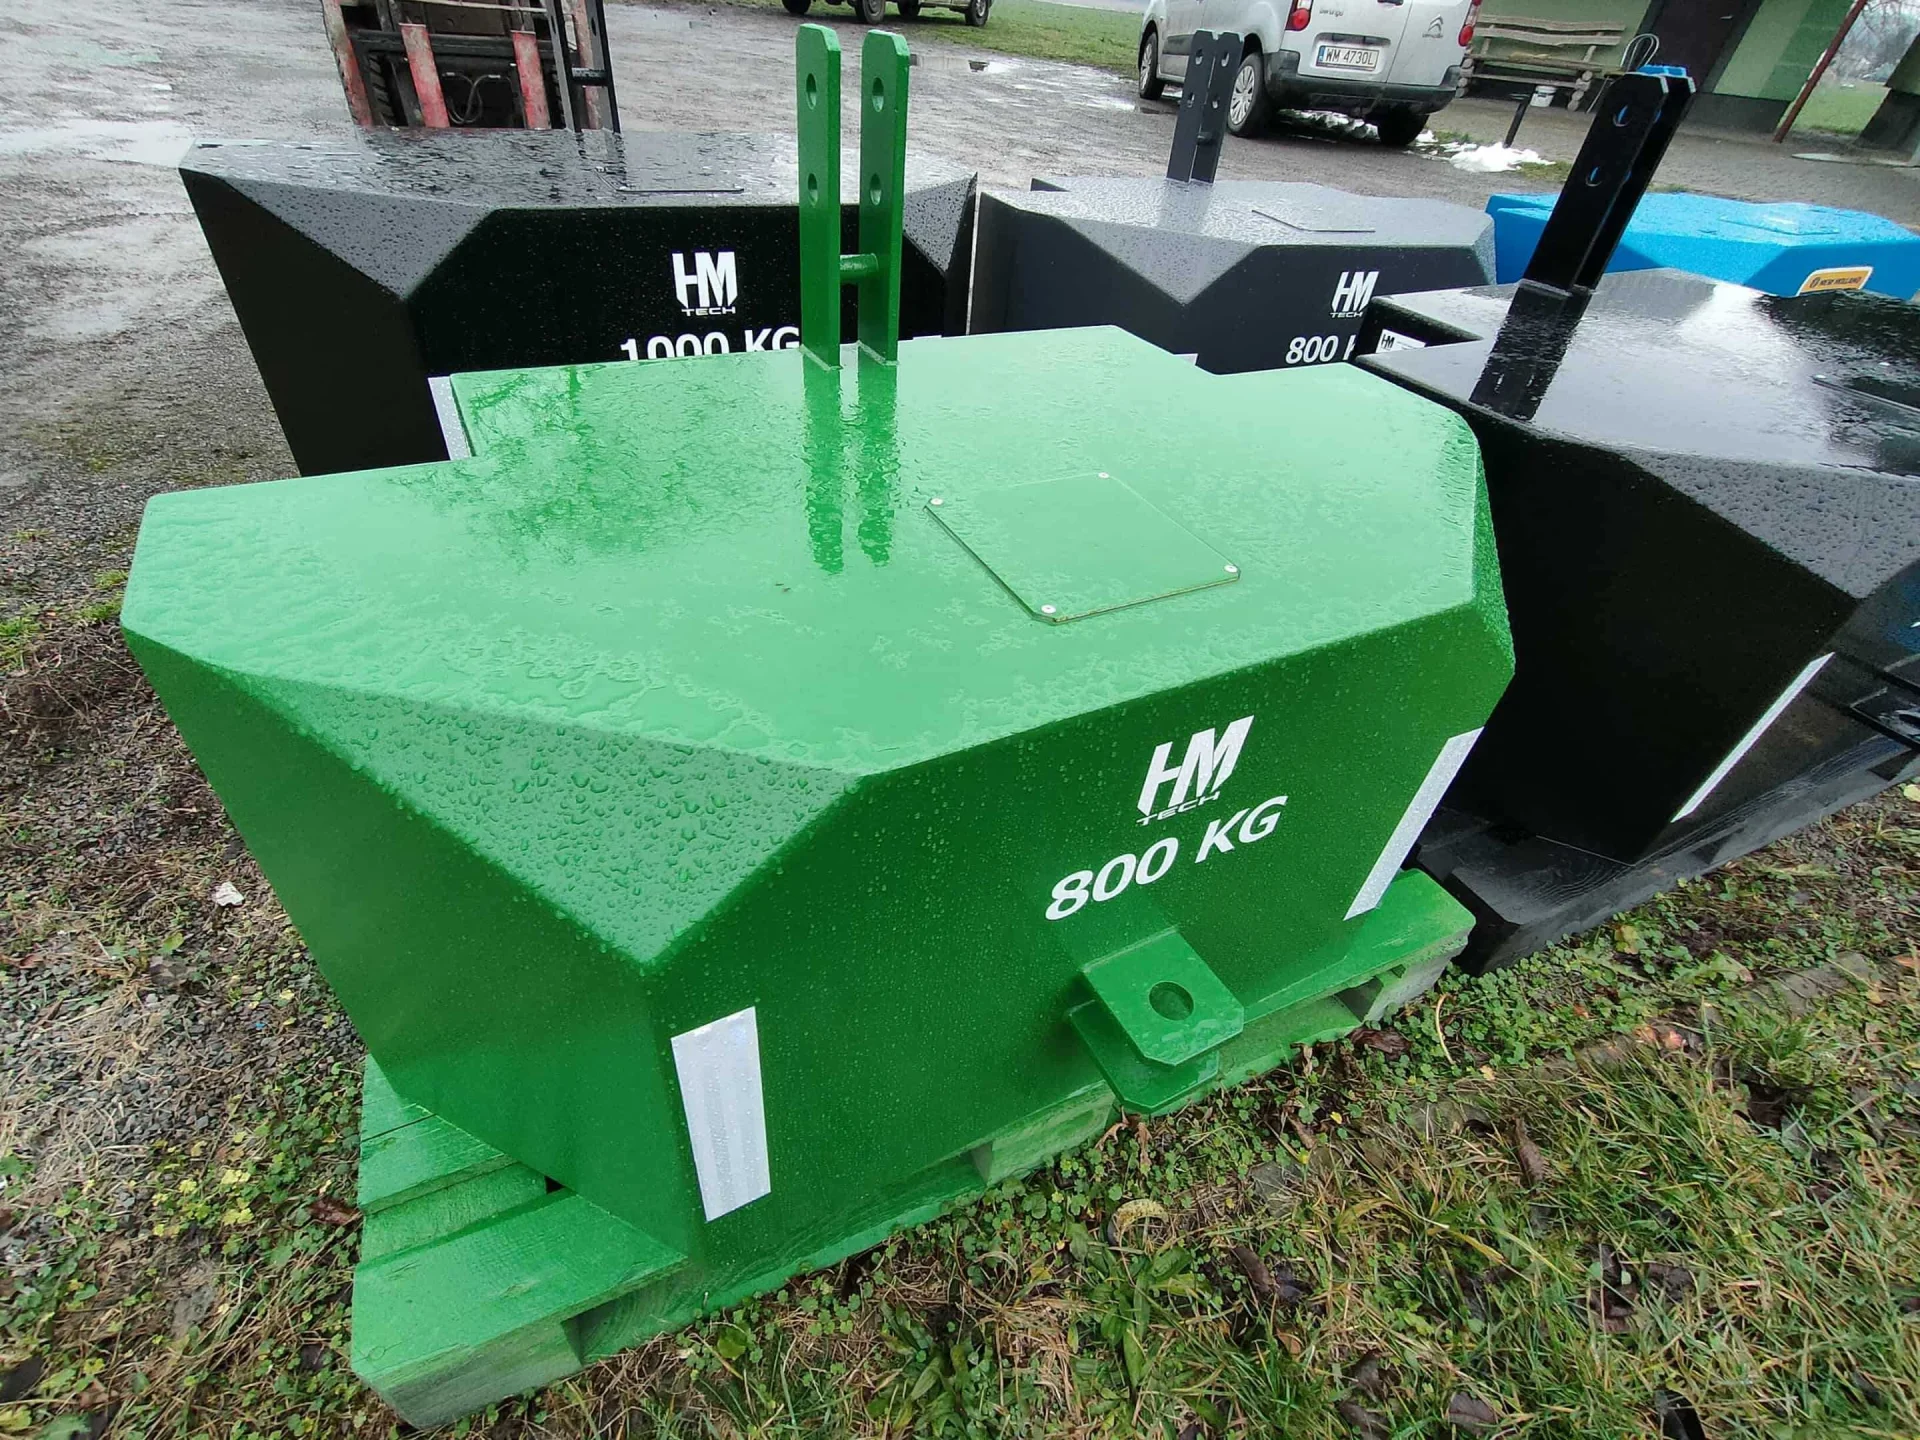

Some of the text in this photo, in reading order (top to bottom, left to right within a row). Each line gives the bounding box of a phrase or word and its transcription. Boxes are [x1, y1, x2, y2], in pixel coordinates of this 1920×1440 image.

[1326, 49, 1341, 62] WM
[1343, 50, 1374, 65] 4730L
[672, 252, 738, 309] HM
[1332, 271, 1379, 312] HM
[682, 306, 736, 316] TECH
[1285, 335, 1339, 364] 800
[1137, 715, 1254, 816] HM
[1136, 791, 1220, 826] TECH
[1045, 795, 1289, 921] 800 KG
